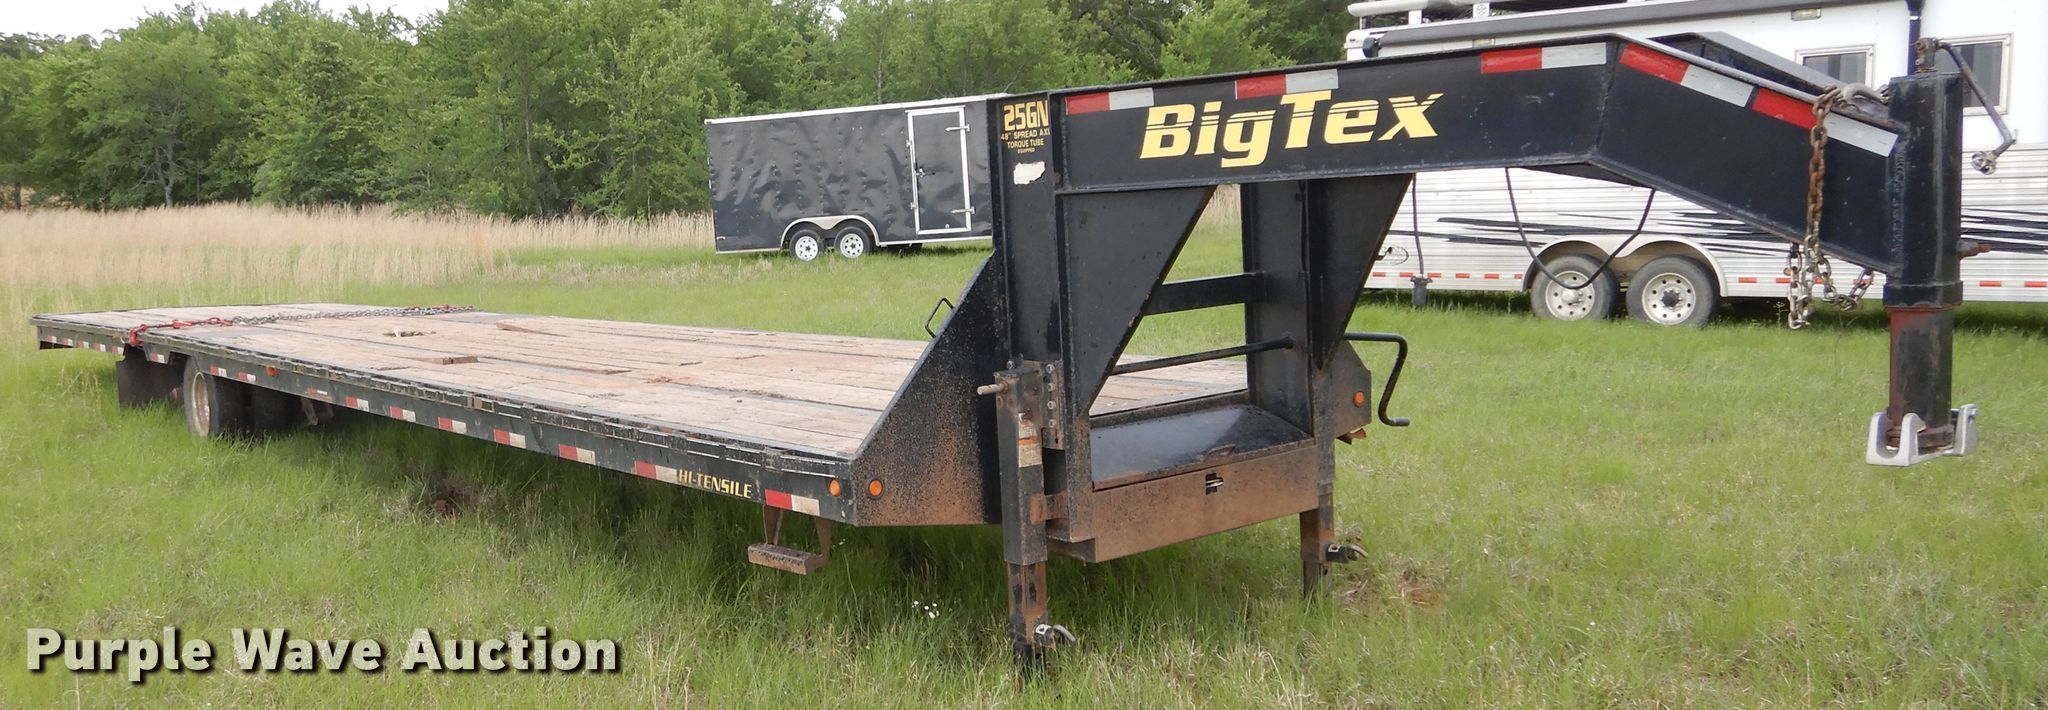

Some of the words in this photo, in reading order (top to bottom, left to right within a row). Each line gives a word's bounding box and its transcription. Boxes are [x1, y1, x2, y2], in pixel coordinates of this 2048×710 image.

[1003, 100, 1049, 131] 25GN
[1007, 140, 1030, 149] TORQUE
[1030, 138, 1044, 147] TUBE
[1013, 130, 1038, 140] SPREAD
[678, 469, 752, 498] HI-TENSILE
